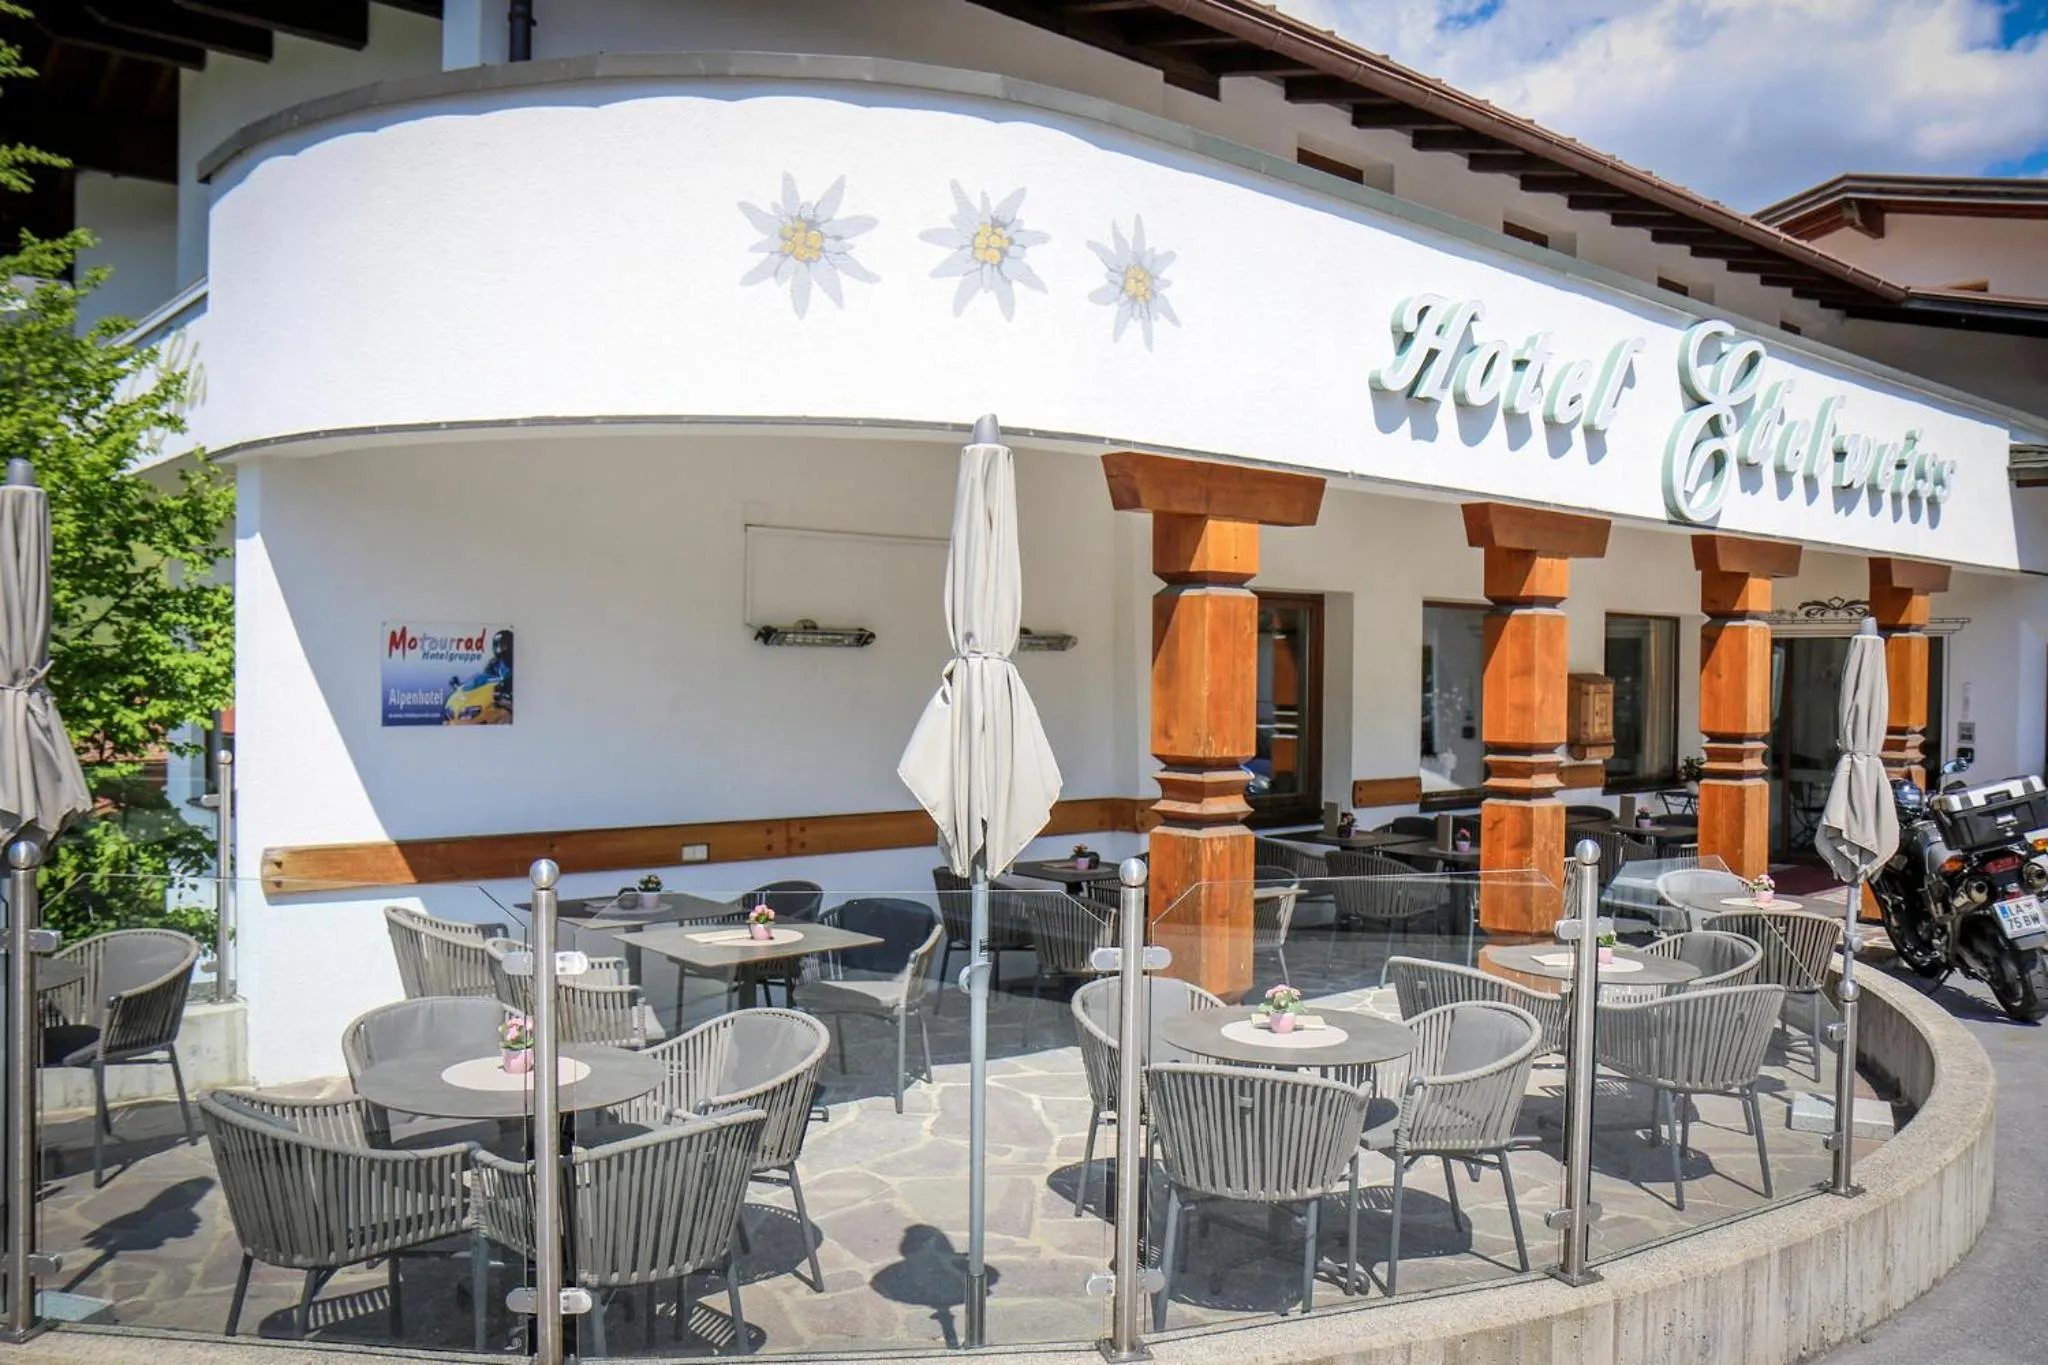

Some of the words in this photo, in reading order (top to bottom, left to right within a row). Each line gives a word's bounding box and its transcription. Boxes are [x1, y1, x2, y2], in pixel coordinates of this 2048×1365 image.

[1369, 293, 1646, 433] Hotel
[1661, 318, 1959, 524] Edelweiss
[388, 626, 486, 660] Motourrad
[422, 650, 482, 663] Hotelgruppe
[388, 688, 443, 710] Alpenhotel
[2008, 904, 2024, 916] LA
[2008, 917, 2022, 929] 75
[2023, 912, 2040, 926] BW
